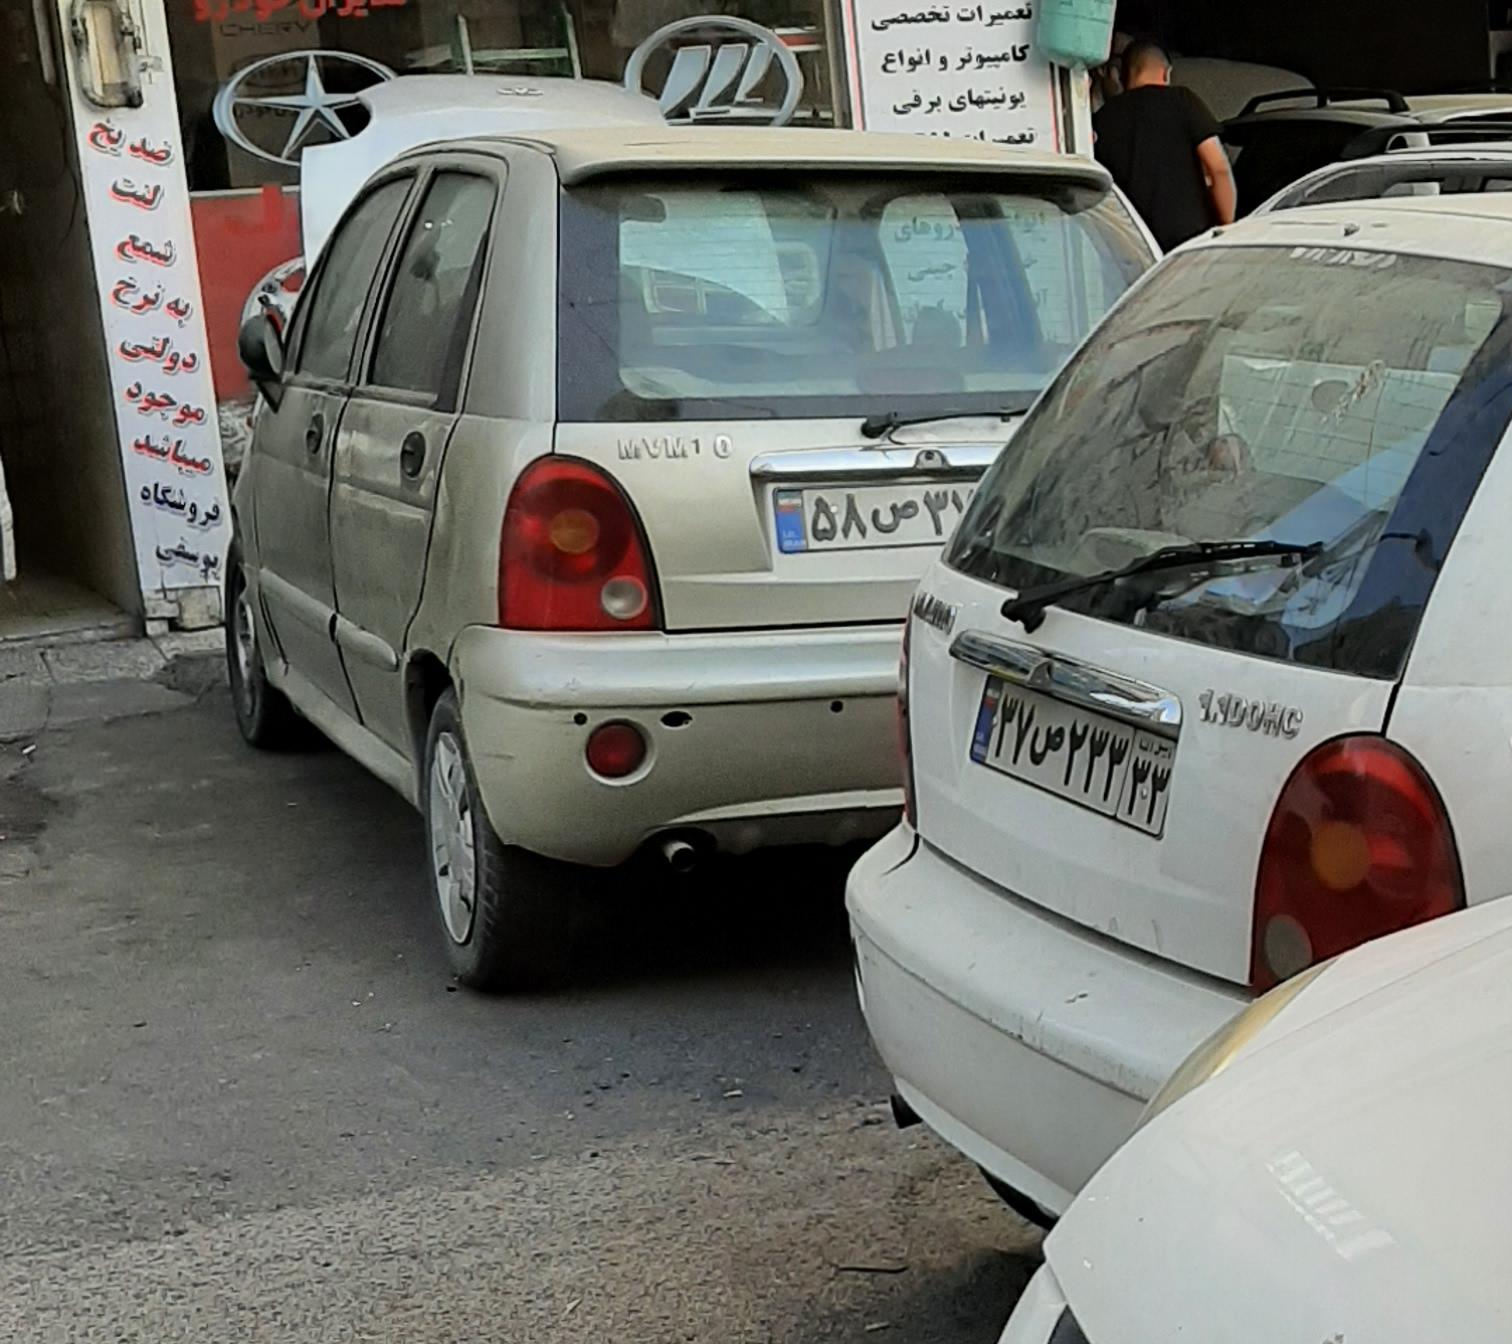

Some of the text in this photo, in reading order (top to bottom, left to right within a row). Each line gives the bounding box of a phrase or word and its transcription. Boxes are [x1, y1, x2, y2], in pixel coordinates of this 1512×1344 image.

[871, 2, 1033, 32] تعمیرات تخصصی
[880, 47, 931, 74] انواع
[937, 54, 949, 73] و
[892, 88, 943, 116] برقی
[108, 177, 164, 210] لنت
[115, 233, 176, 267] شمع
[110, 275, 165, 315] نرخ
[119, 334, 199, 372] دولتی
[125, 379, 207, 426] موجود
[141, 481, 221, 527] فروشگاه
[155, 537, 220, 581] یوسفی
[1127, 755, 1172, 825] ۳۳
